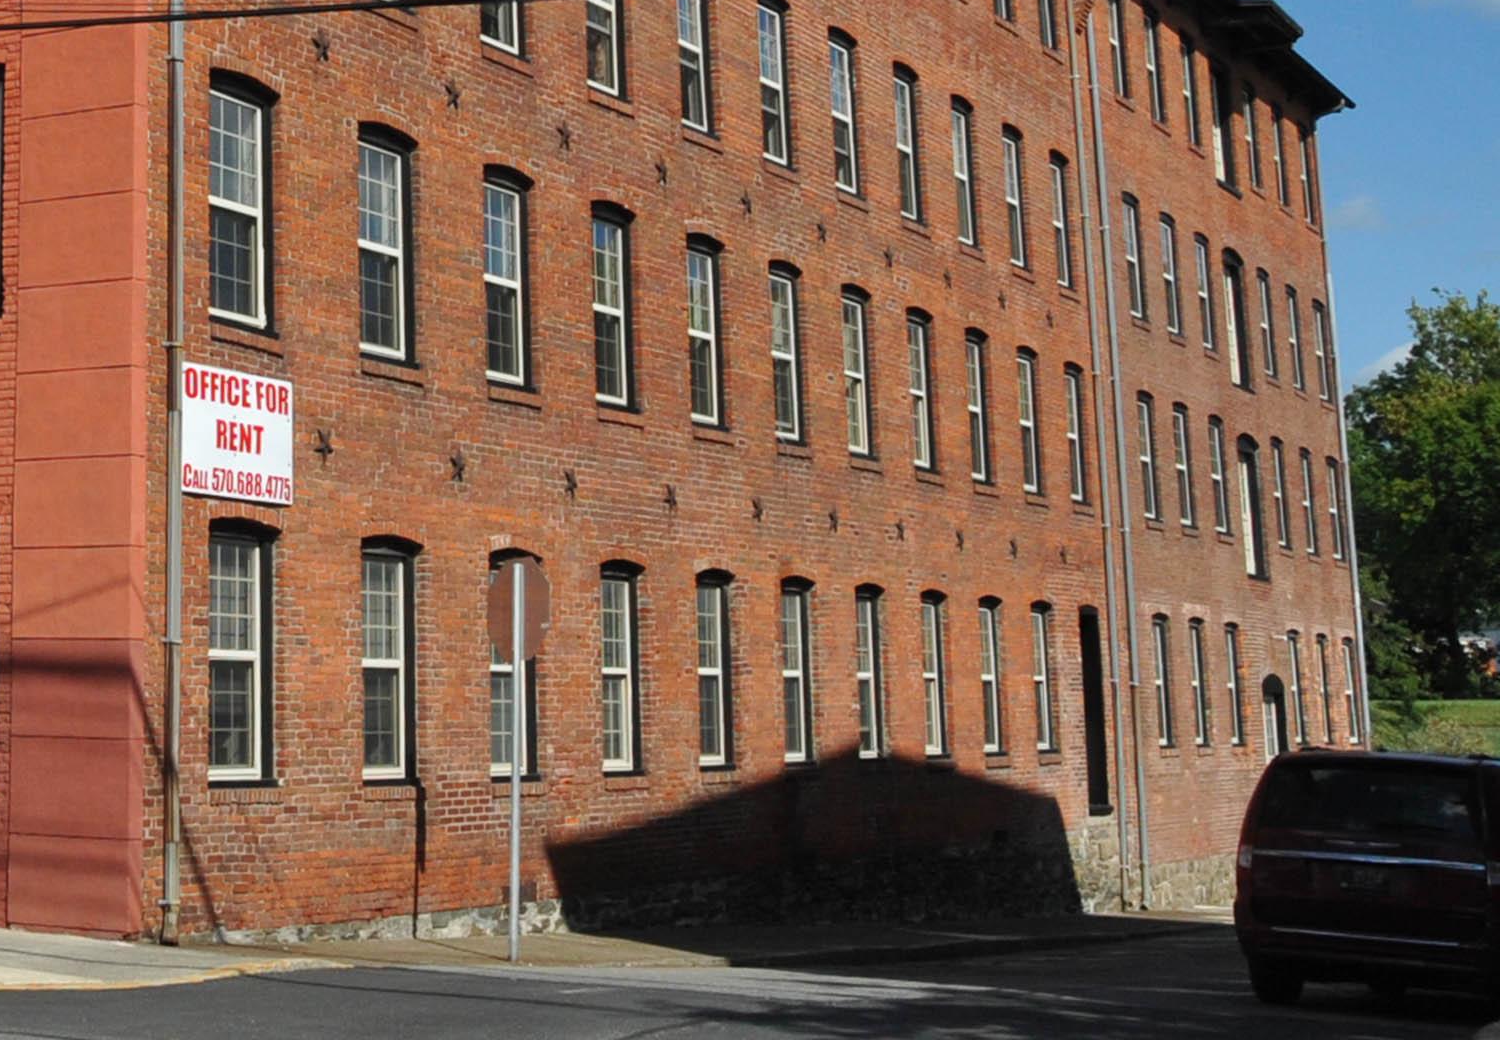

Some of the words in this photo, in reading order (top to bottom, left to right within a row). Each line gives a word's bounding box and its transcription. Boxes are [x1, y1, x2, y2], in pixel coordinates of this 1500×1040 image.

[185, 368, 251, 408] OFFICE
[256, 381, 290, 416] FOR
[216, 419, 264, 454] RENT
[212, 467, 291, 501] 570.688.4775
